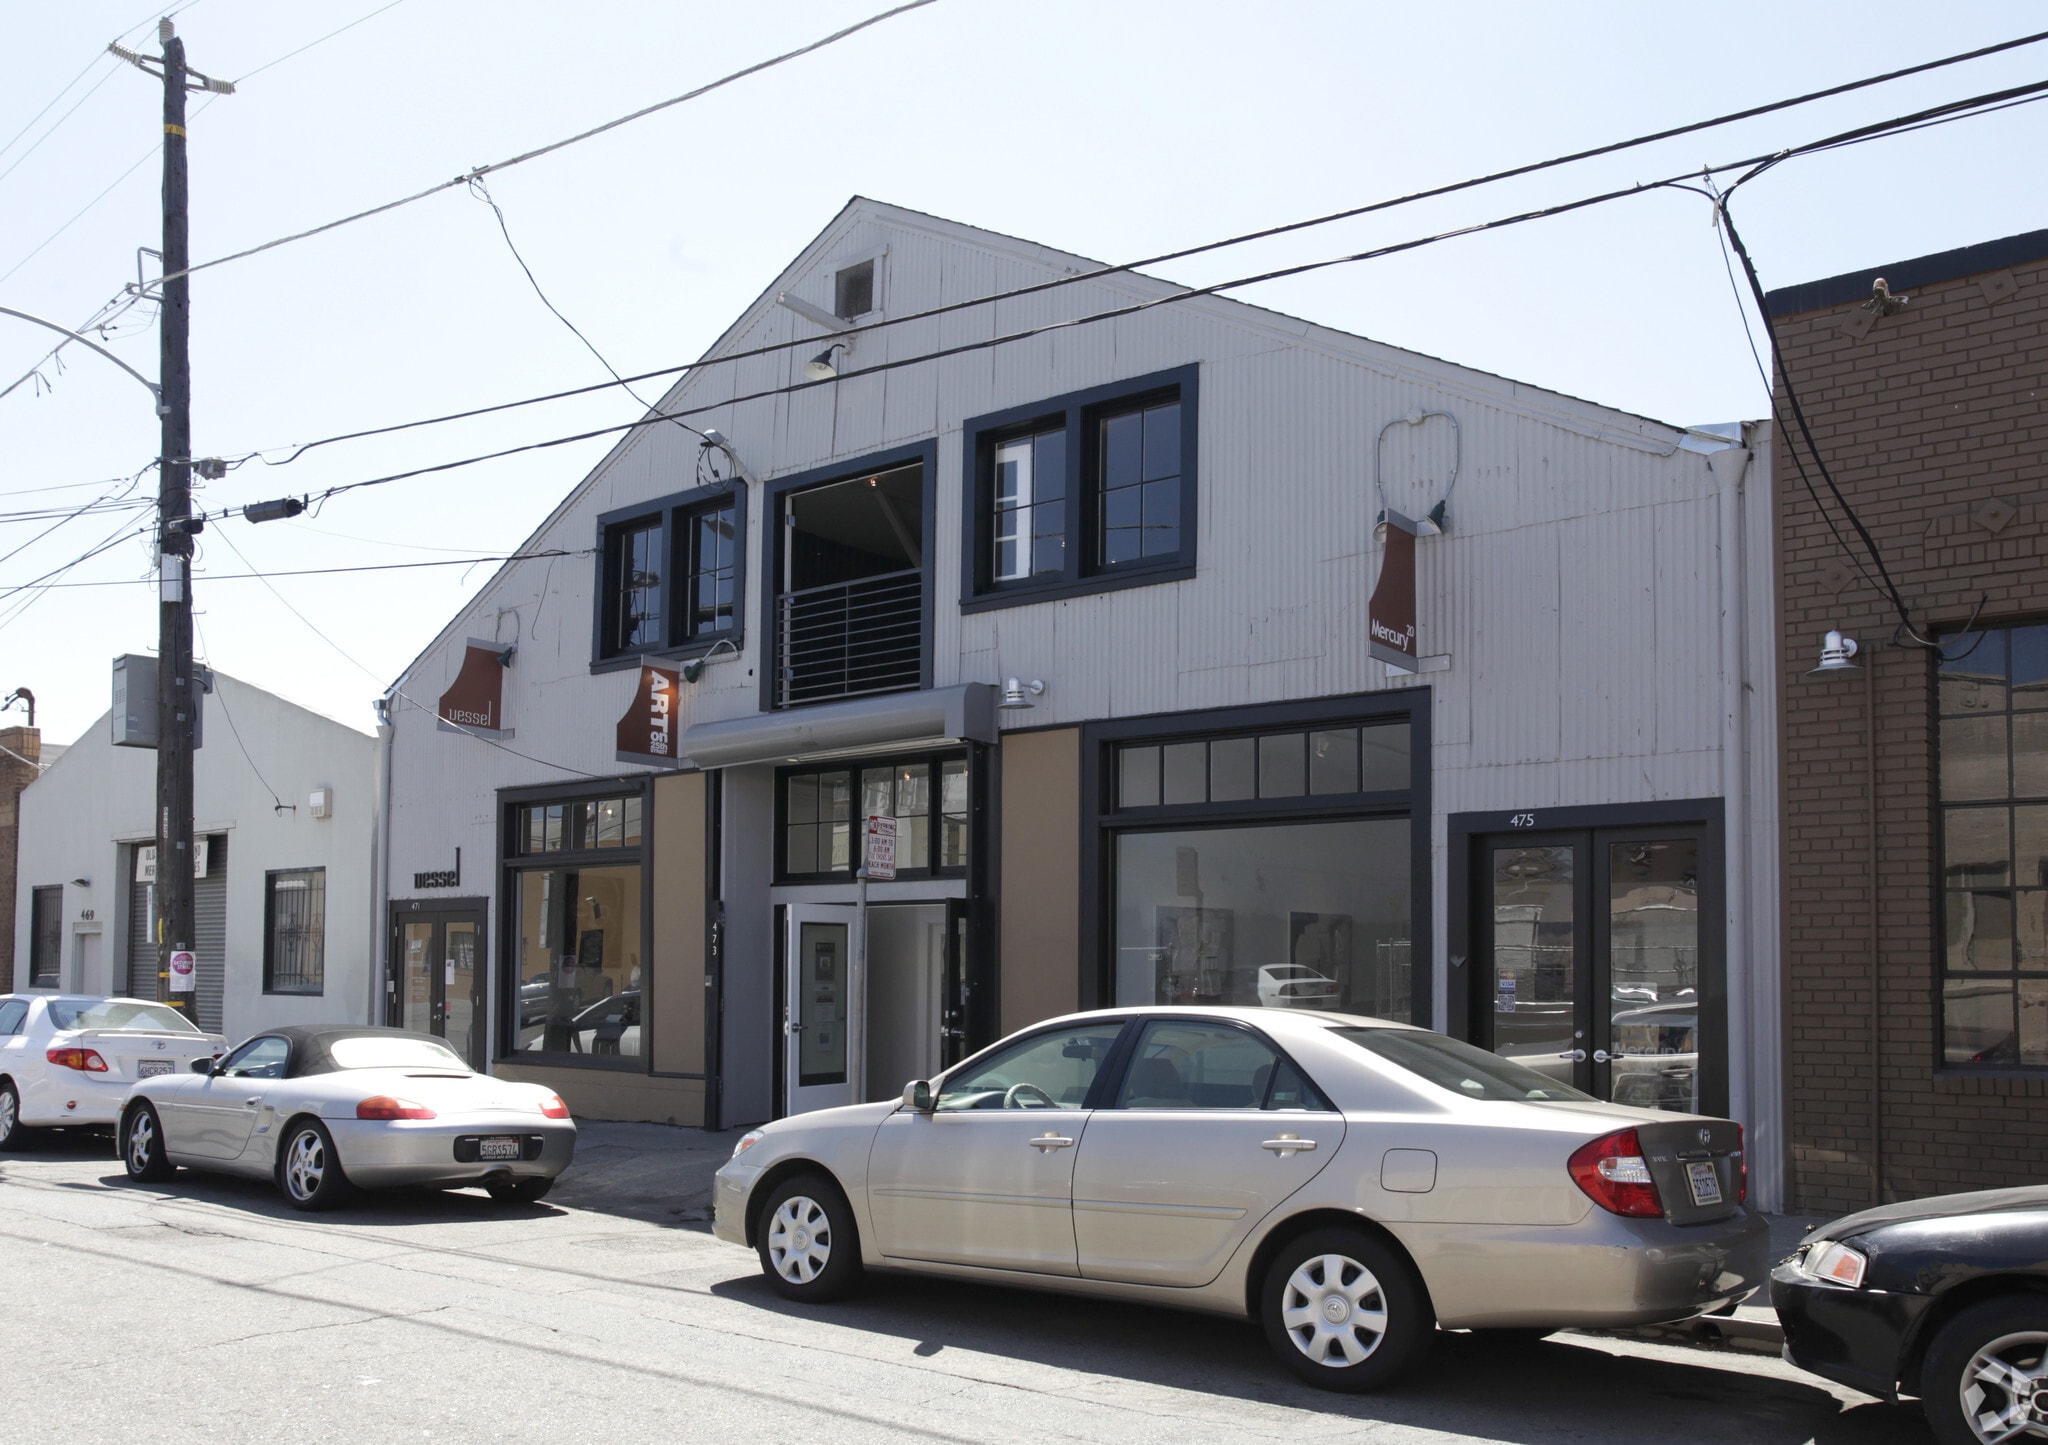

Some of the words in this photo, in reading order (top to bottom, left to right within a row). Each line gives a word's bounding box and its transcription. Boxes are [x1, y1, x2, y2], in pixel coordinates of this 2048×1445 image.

[1371, 618, 1409, 651] Mercury
[650, 670, 669, 733] ART
[650, 731, 668, 743] on
[650, 741, 668, 750] 25th
[1510, 813, 1534, 827] 475
[411, 902, 421, 910] 471
[80, 909, 95, 920] 469
